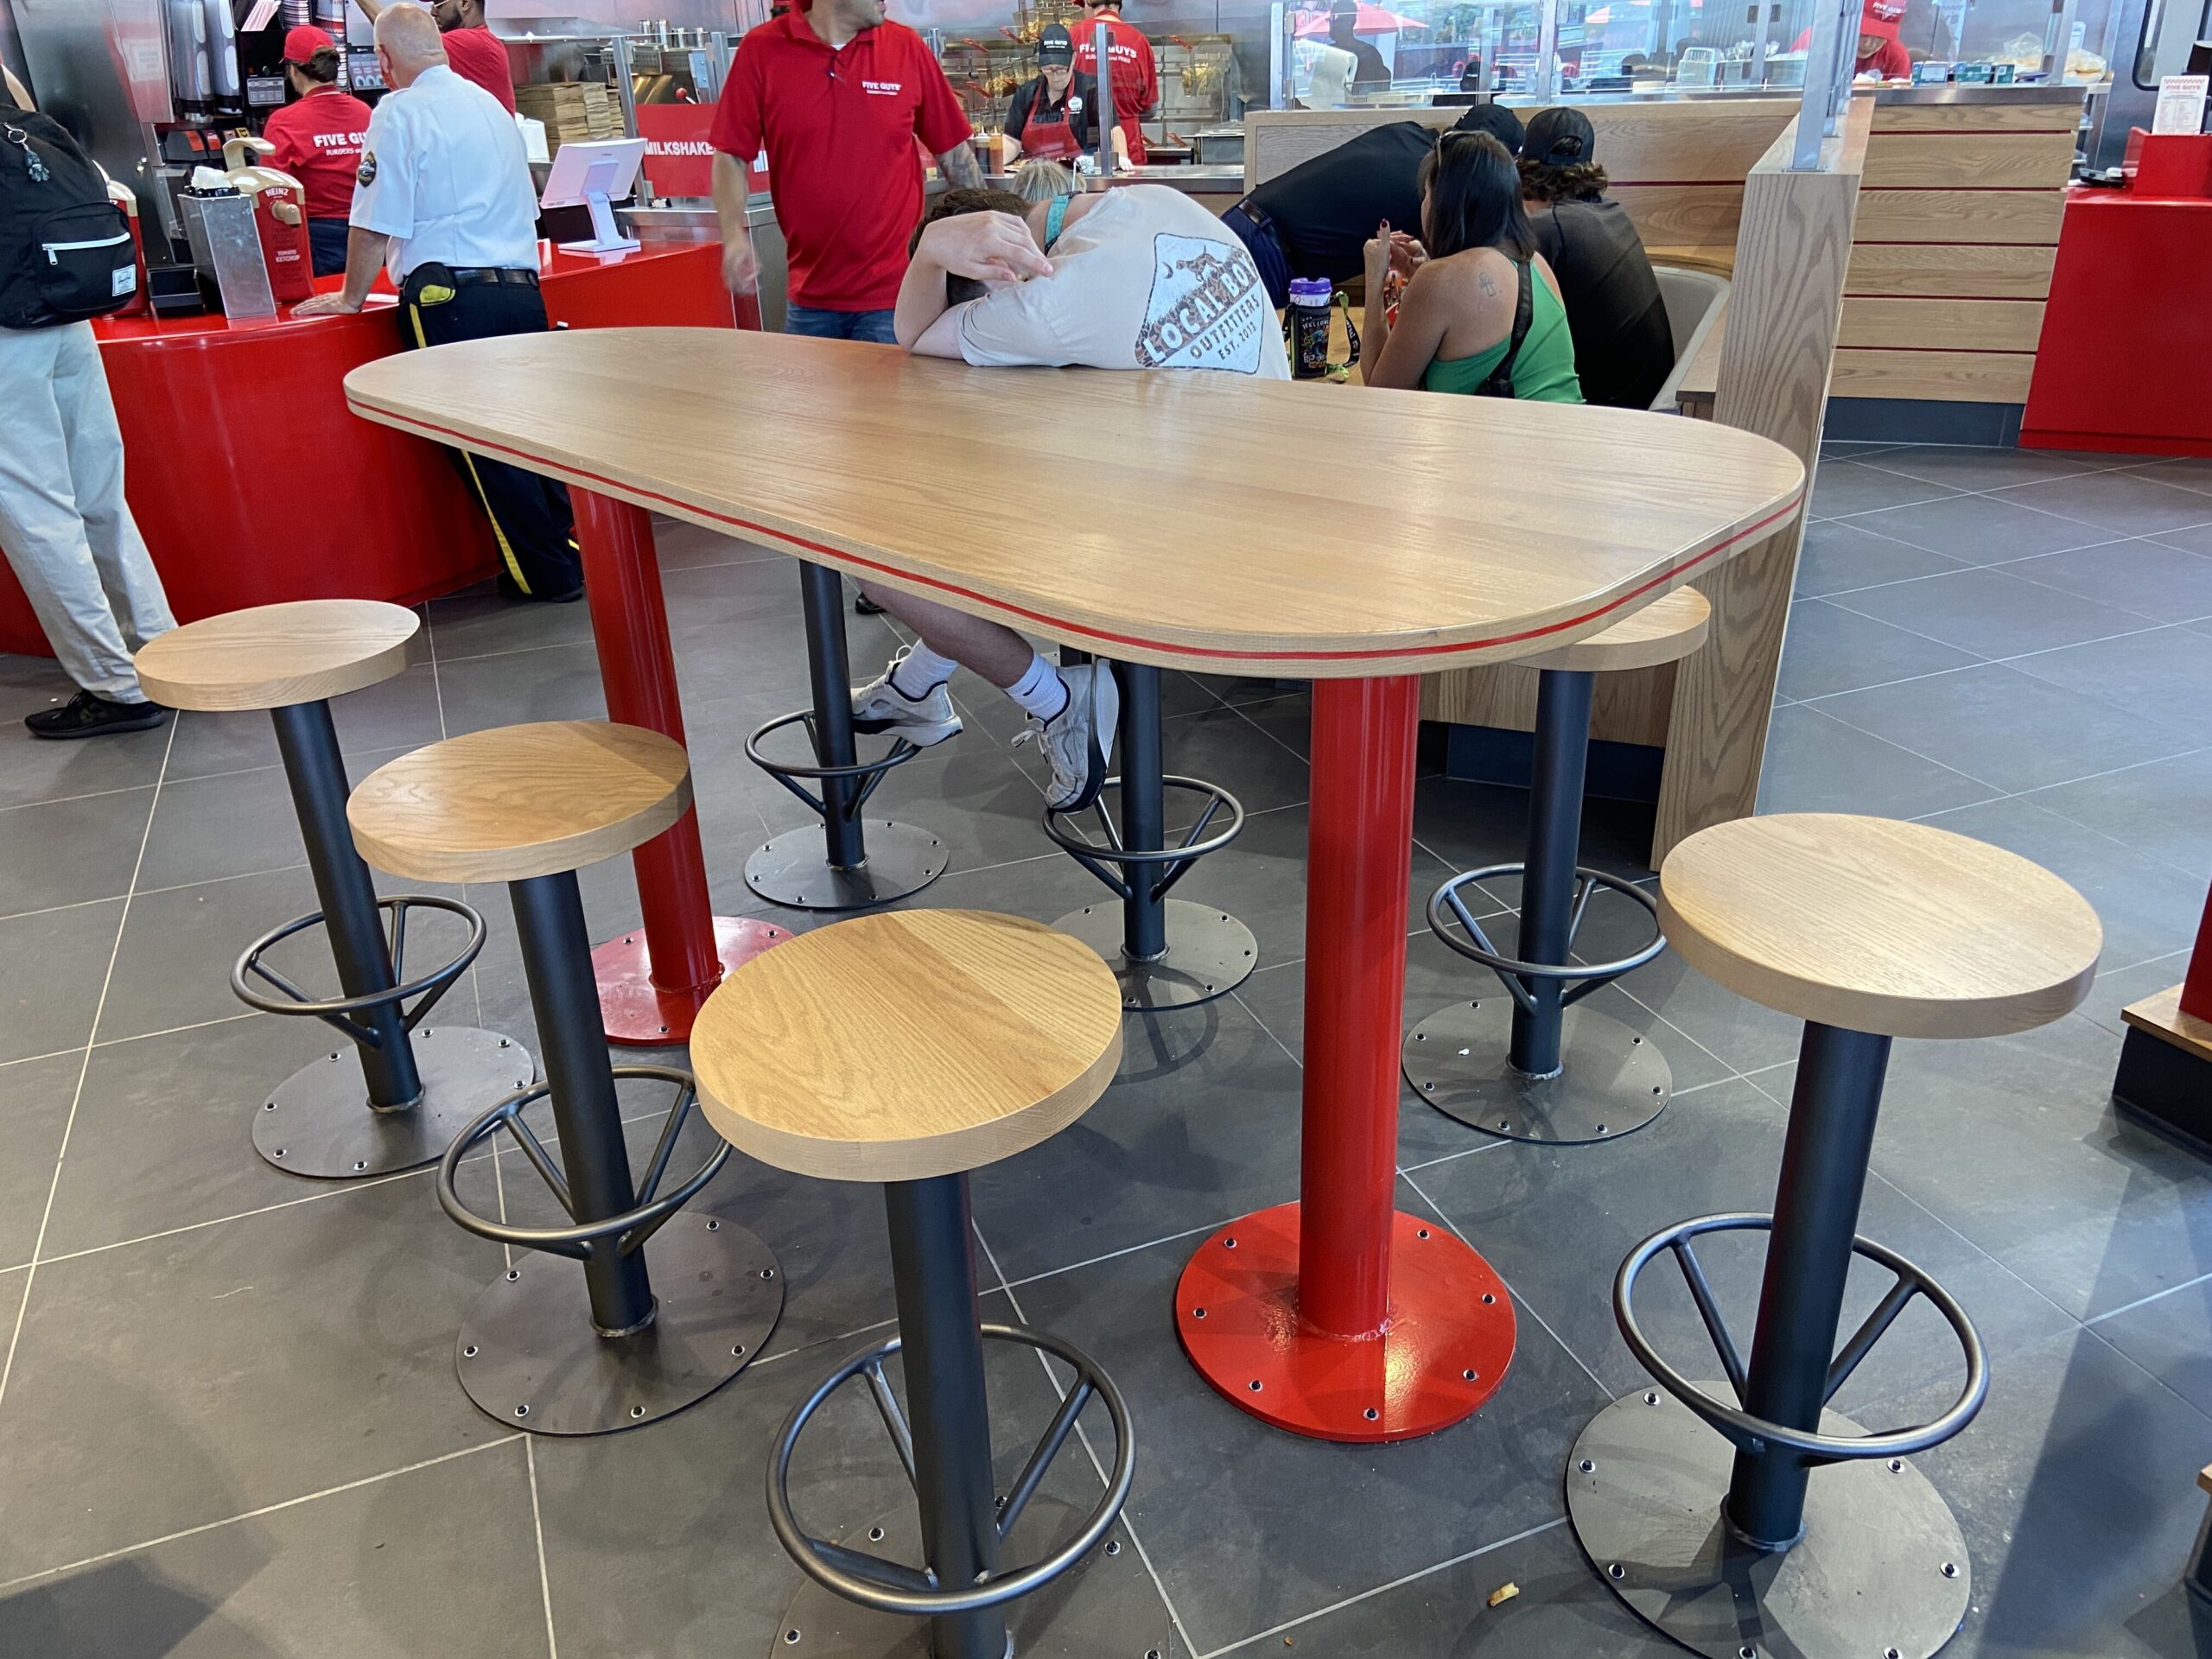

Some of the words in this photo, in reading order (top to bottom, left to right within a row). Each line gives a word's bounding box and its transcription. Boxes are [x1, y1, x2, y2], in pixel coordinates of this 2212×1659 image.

[313, 134, 347, 147] FIVE
[348, 132, 366, 144] GU
[645, 141, 716, 156] MILKSHAKE
[265, 188, 289, 197] HEINZ
[1143, 290, 1224, 362] LOCAL
[1220, 254, 1259, 297] BOY
[1191, 295, 1259, 359] OUTFITTERS
[1218, 339, 1239, 359] EST.
